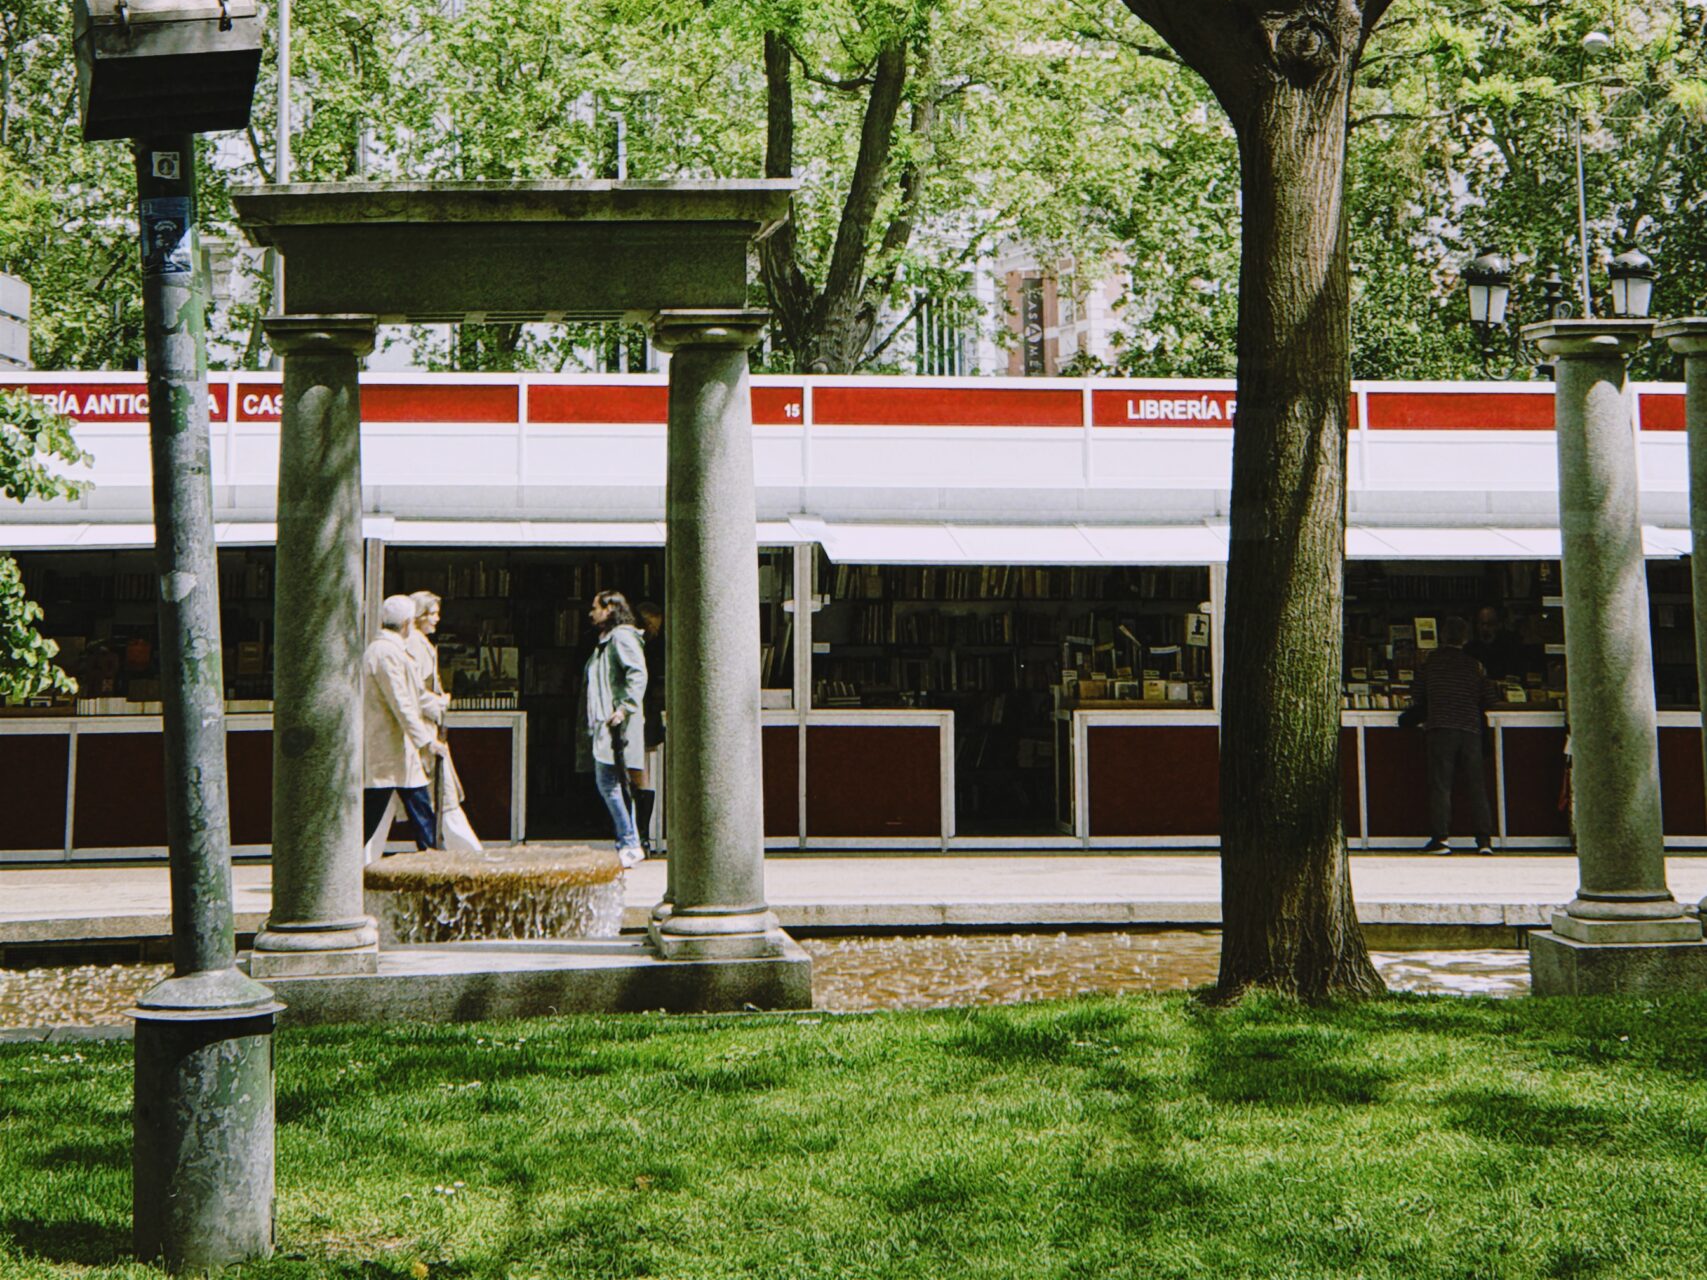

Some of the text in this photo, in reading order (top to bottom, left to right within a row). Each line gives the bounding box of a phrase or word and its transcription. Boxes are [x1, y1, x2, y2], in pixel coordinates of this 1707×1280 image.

[82, 394, 220, 415] ANTICA
[242, 394, 283, 415] CAS
[784, 403, 800, 418] 15
[1127, 395, 1222, 420] LIBRERÍA
